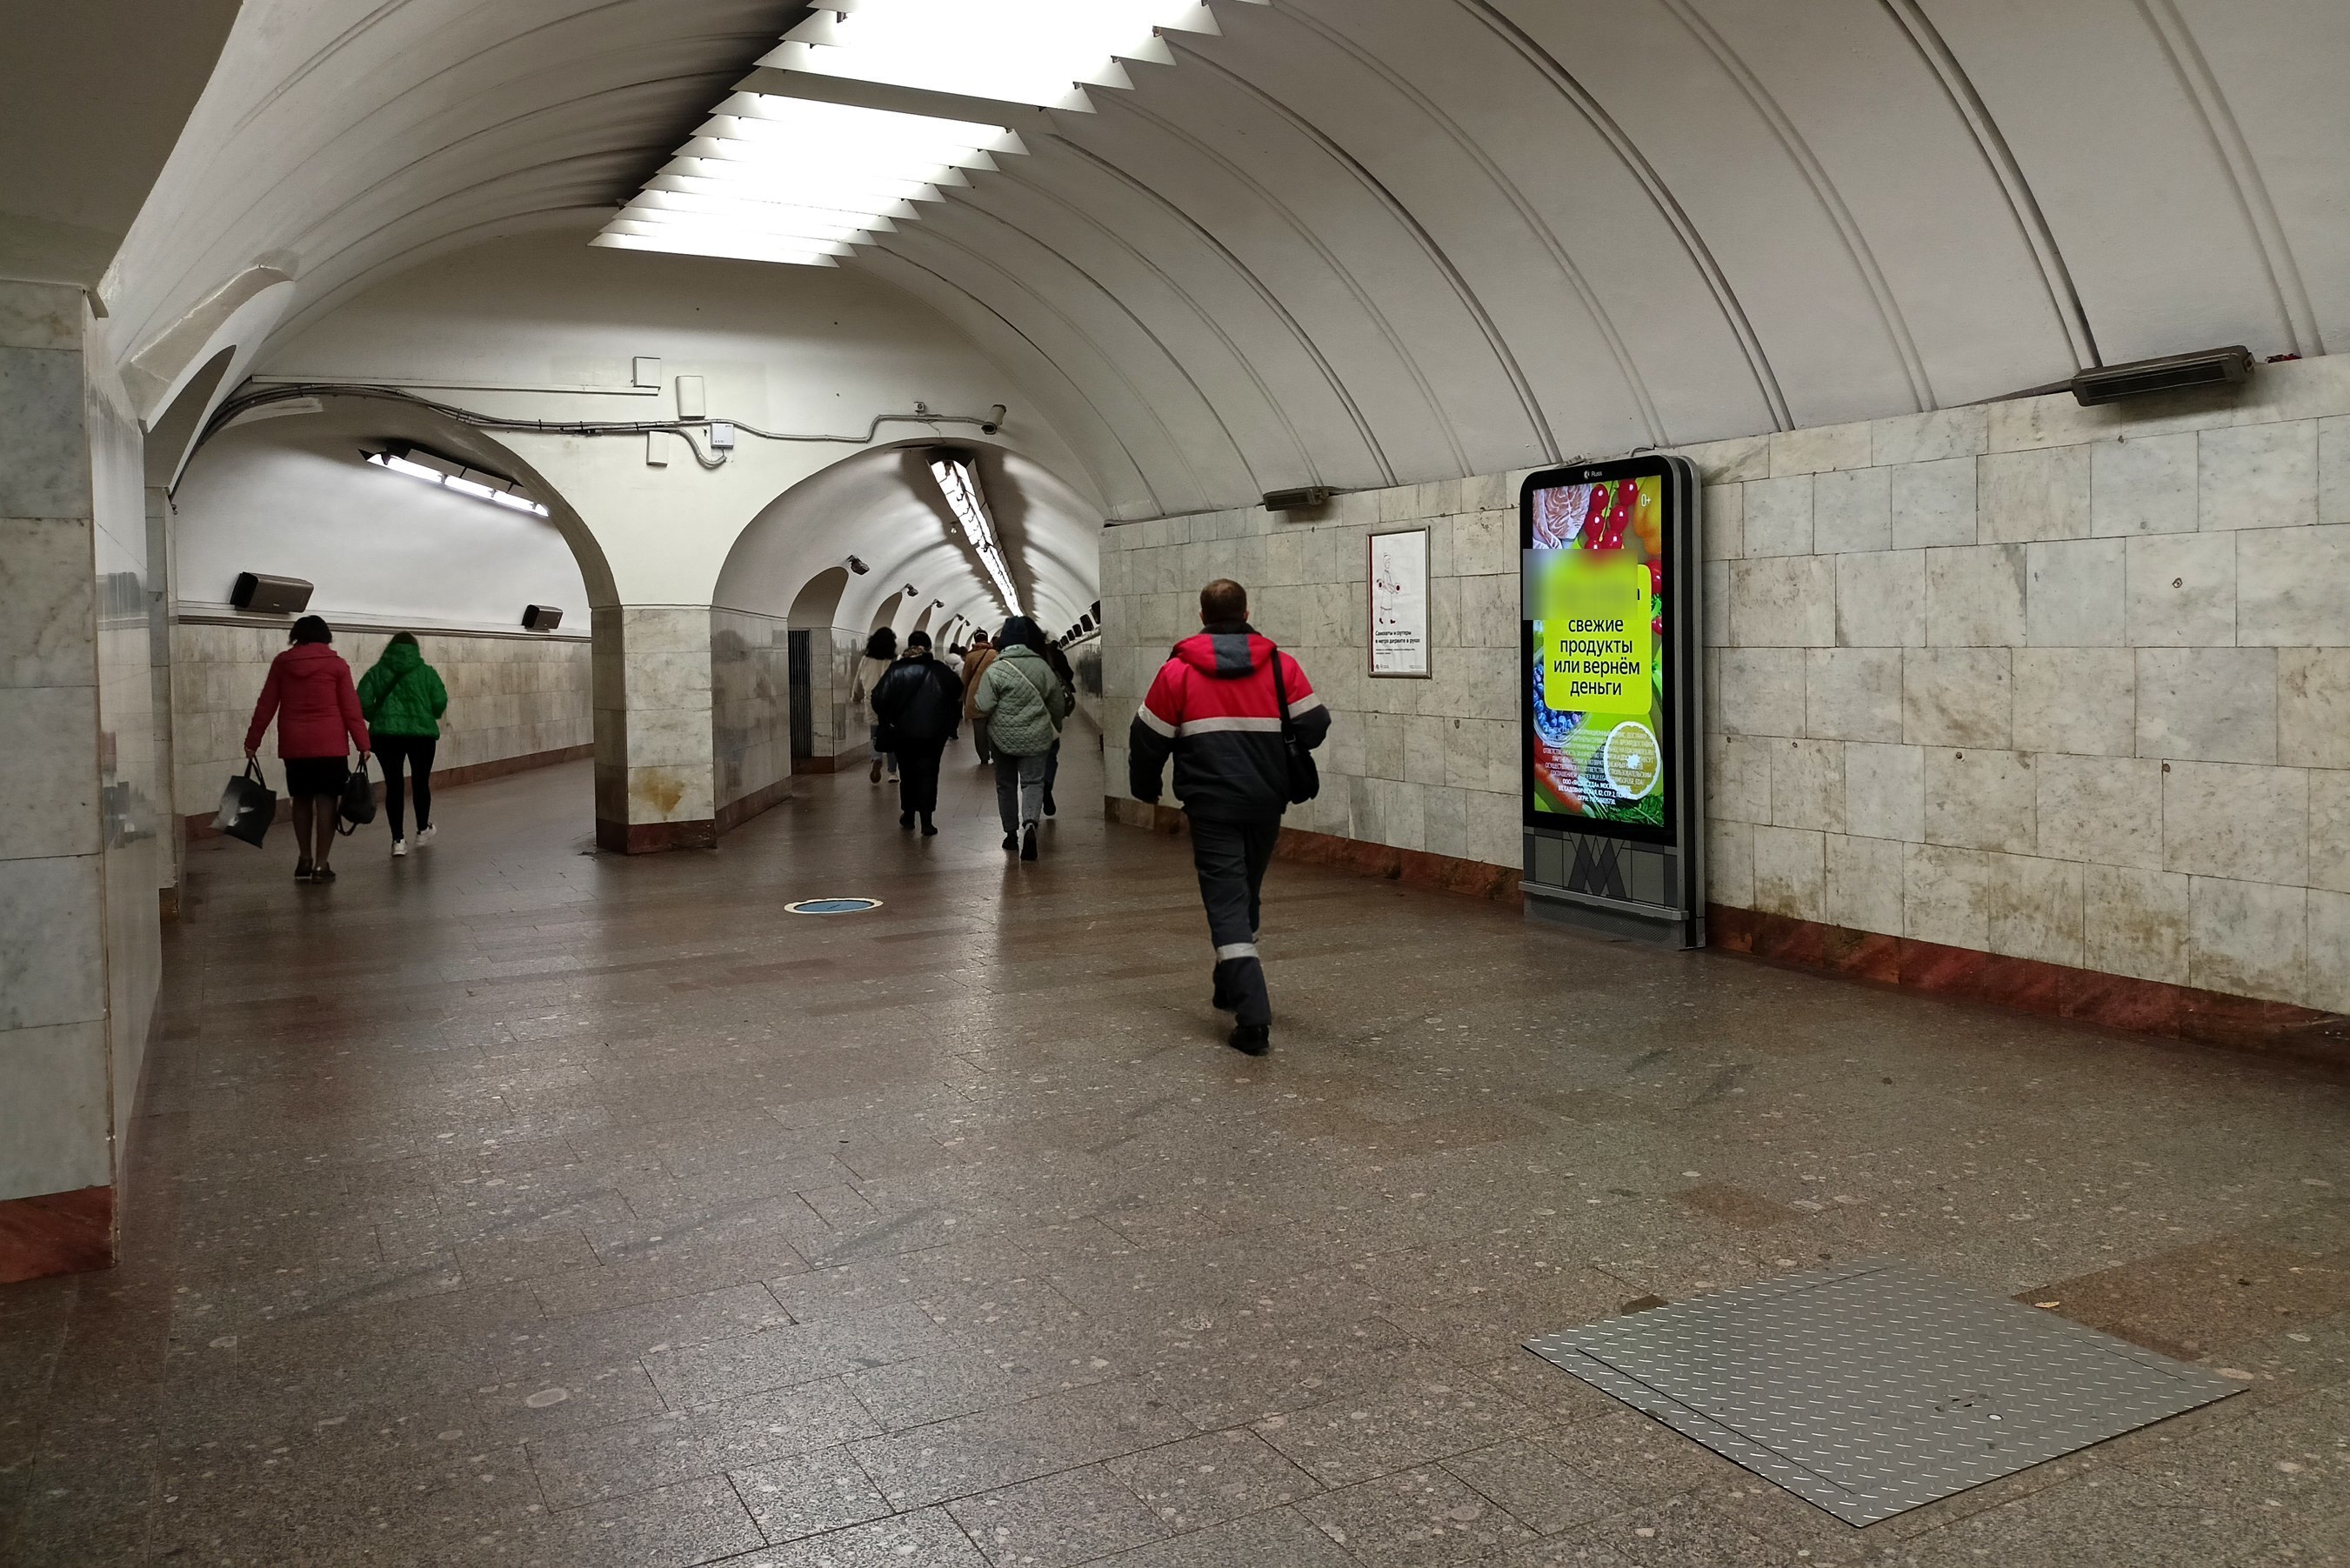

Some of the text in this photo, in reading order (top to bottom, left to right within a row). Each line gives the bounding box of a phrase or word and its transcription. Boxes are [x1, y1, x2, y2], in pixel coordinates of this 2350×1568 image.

[1640, 493, 1652, 507] 0+
[1568, 619, 1624, 632] свежие
[1560, 640, 1632, 657] продукты
[1553, 657, 1640, 677] или вернём
[1570, 681, 1622, 697] деньги
